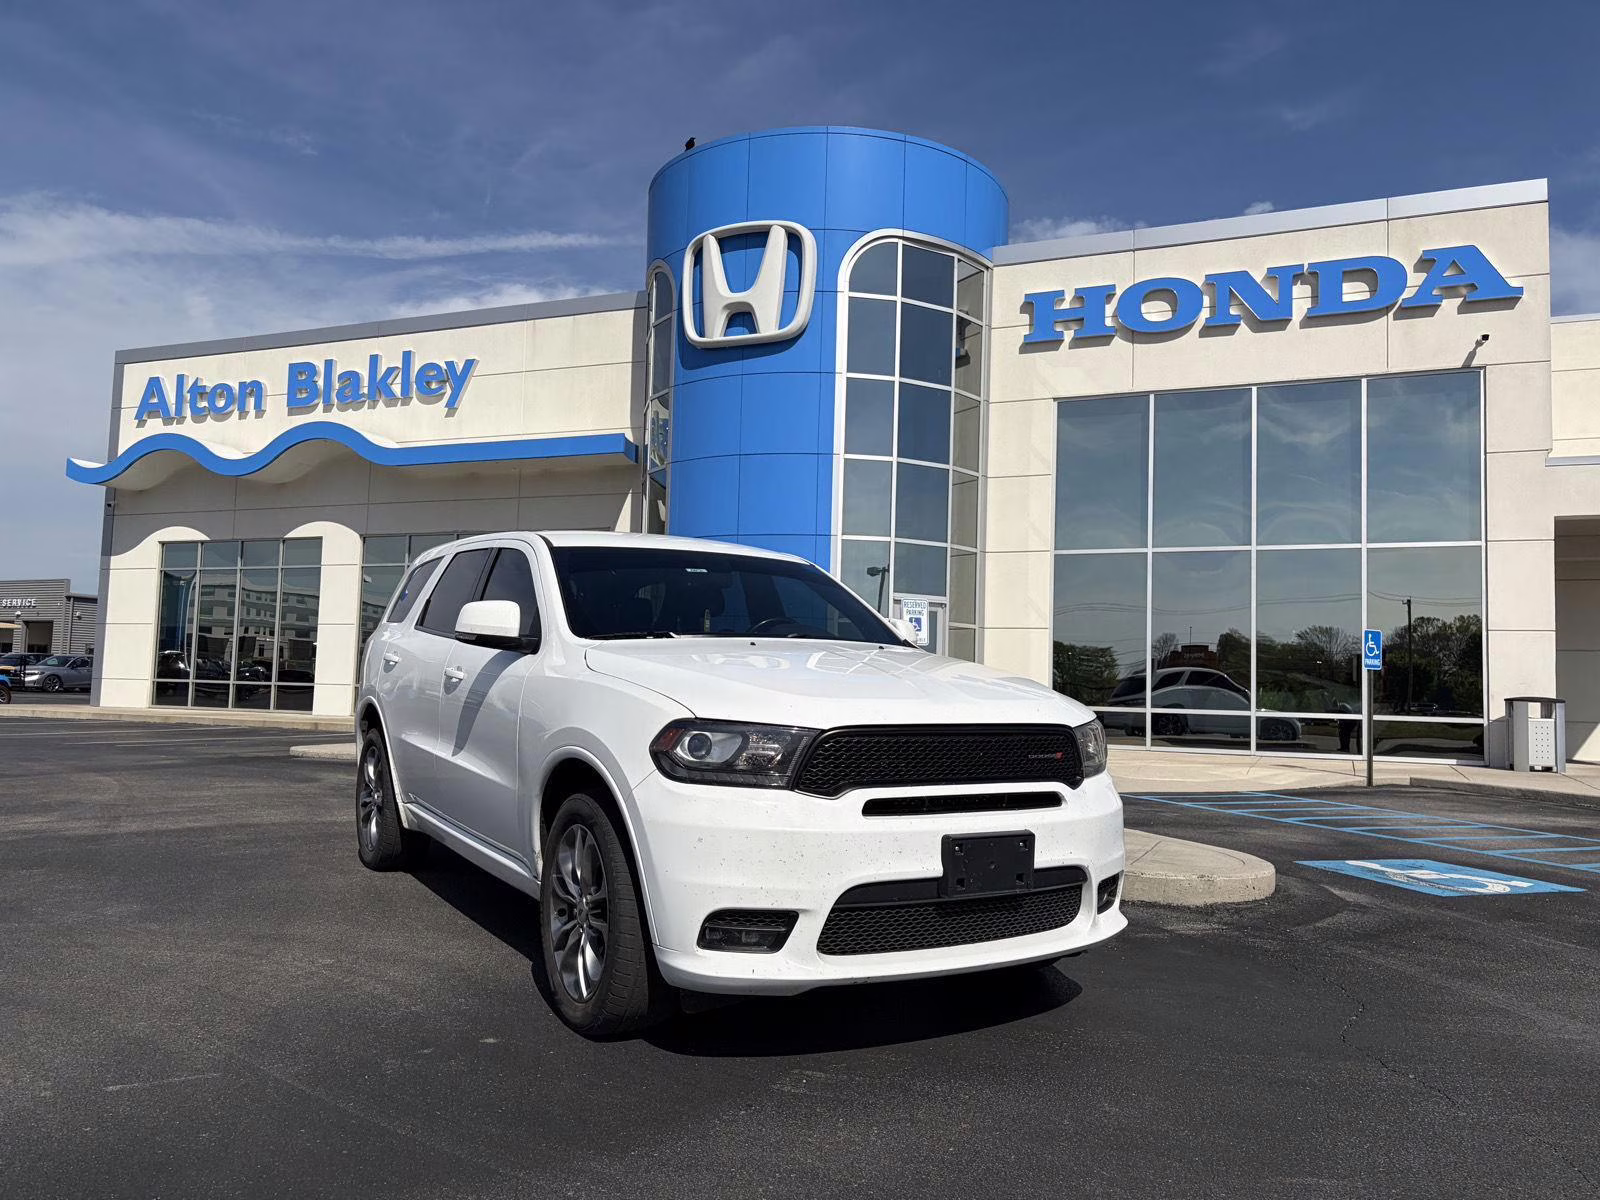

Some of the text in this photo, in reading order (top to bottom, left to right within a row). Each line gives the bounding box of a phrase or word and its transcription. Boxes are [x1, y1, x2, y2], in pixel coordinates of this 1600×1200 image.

[1023, 245, 1524, 344] HONDA
[134, 350, 479, 421] Alton Blakley
[2, 598, 36, 606] SERVICE
[904, 601, 926, 609] RESERVED
